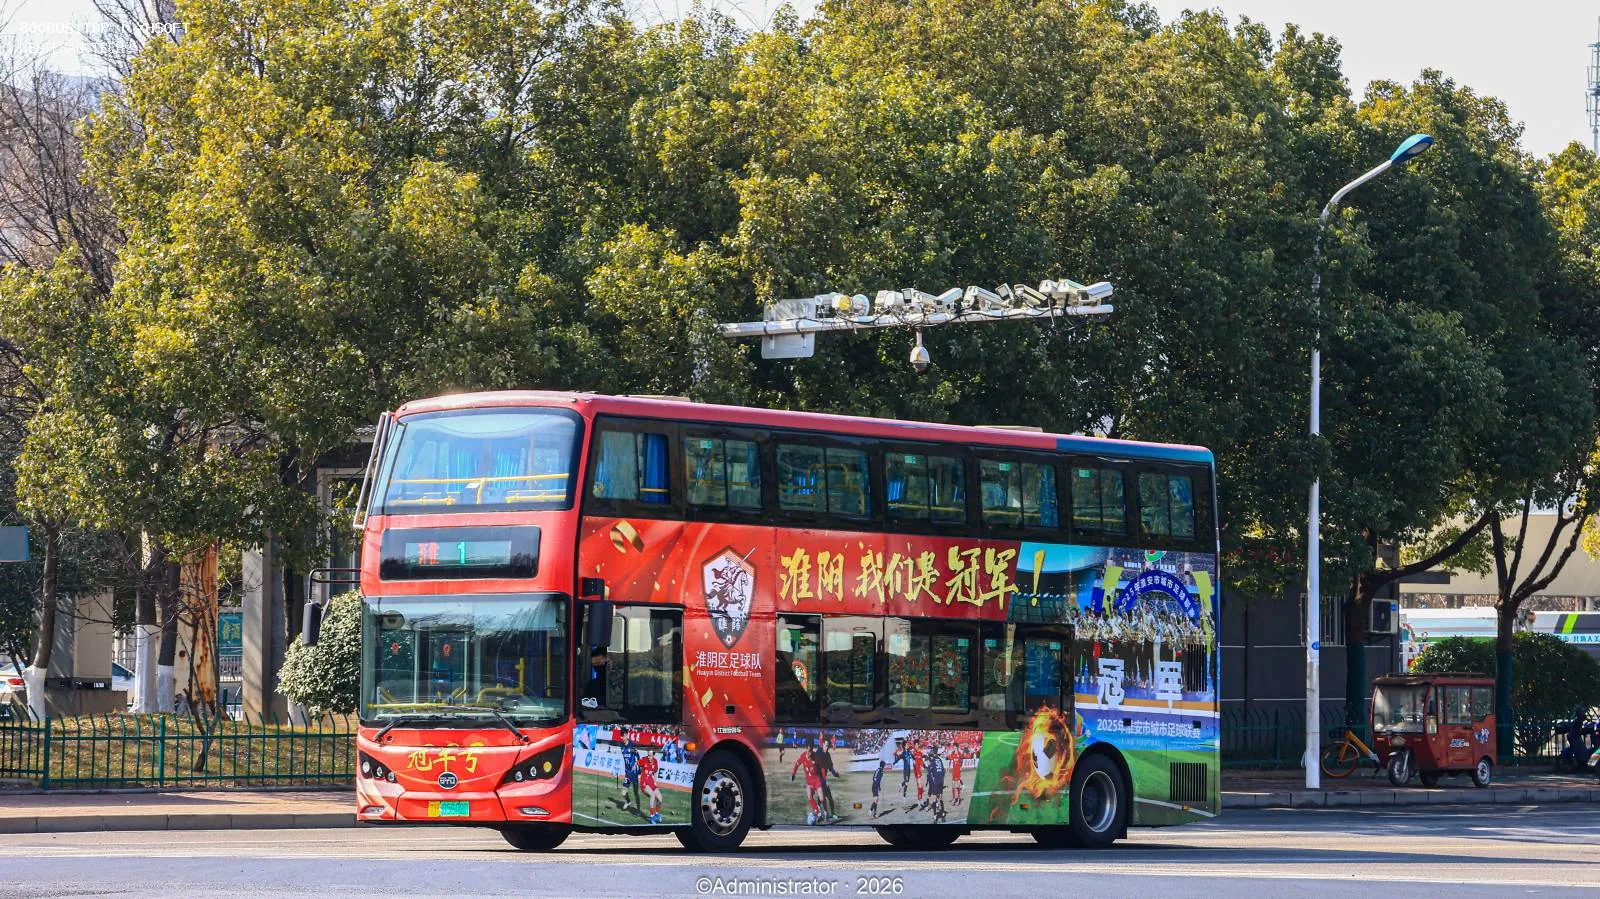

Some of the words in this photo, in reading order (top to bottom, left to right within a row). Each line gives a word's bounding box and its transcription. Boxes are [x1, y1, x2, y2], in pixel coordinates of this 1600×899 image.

[457, 542, 466, 564] 1
[696, 651, 761, 669] 淮阴区足球队
[440, 776, 456, 785] BYD
